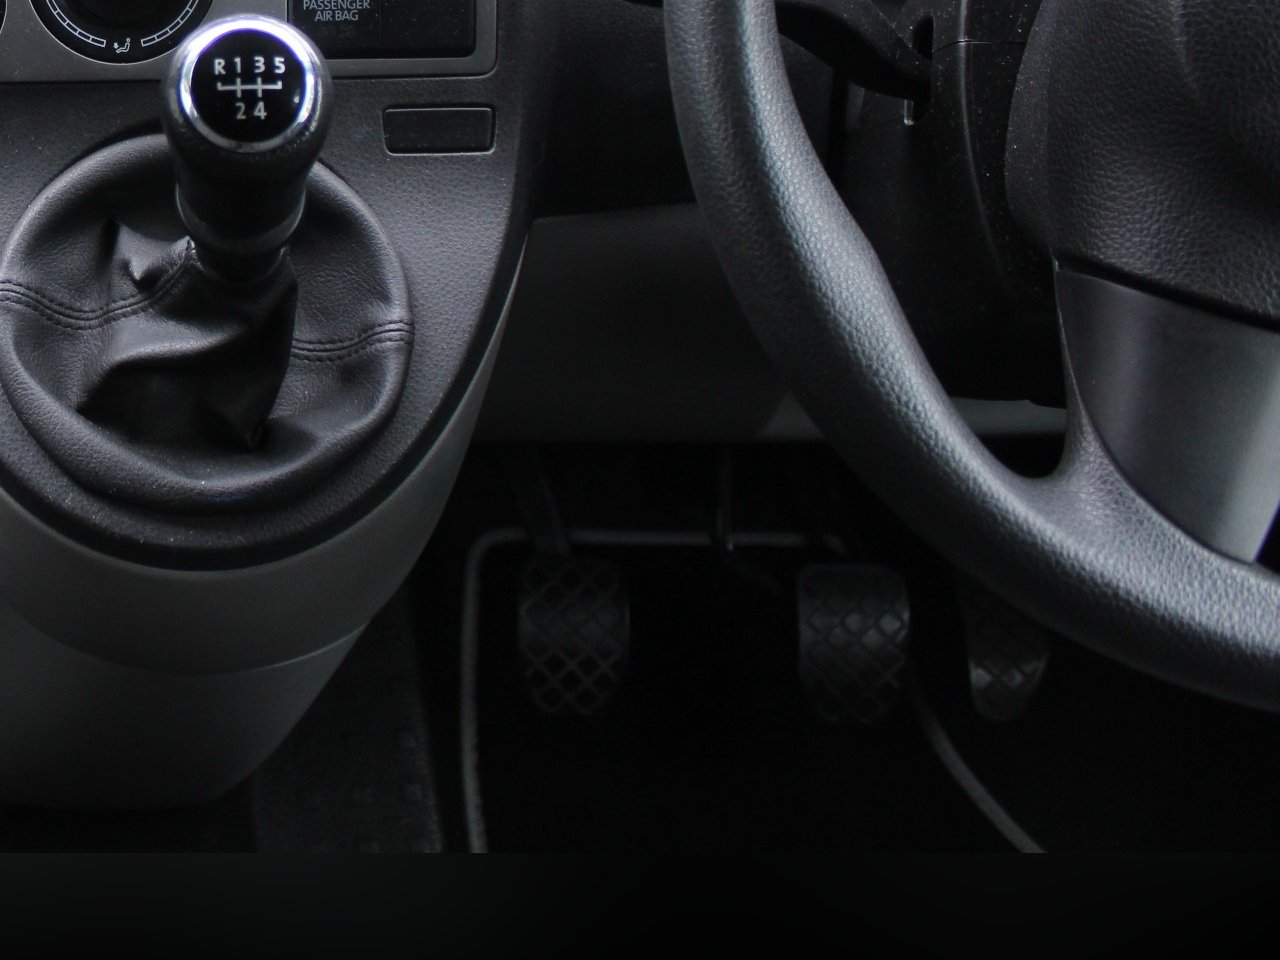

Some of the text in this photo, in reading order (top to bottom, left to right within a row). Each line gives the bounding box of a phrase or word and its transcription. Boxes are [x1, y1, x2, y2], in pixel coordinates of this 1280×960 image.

[314, 10, 359, 22] AIR BAG
[214, 56, 286, 75] R 1 3 5
[235, 101, 267, 120] 2 4
